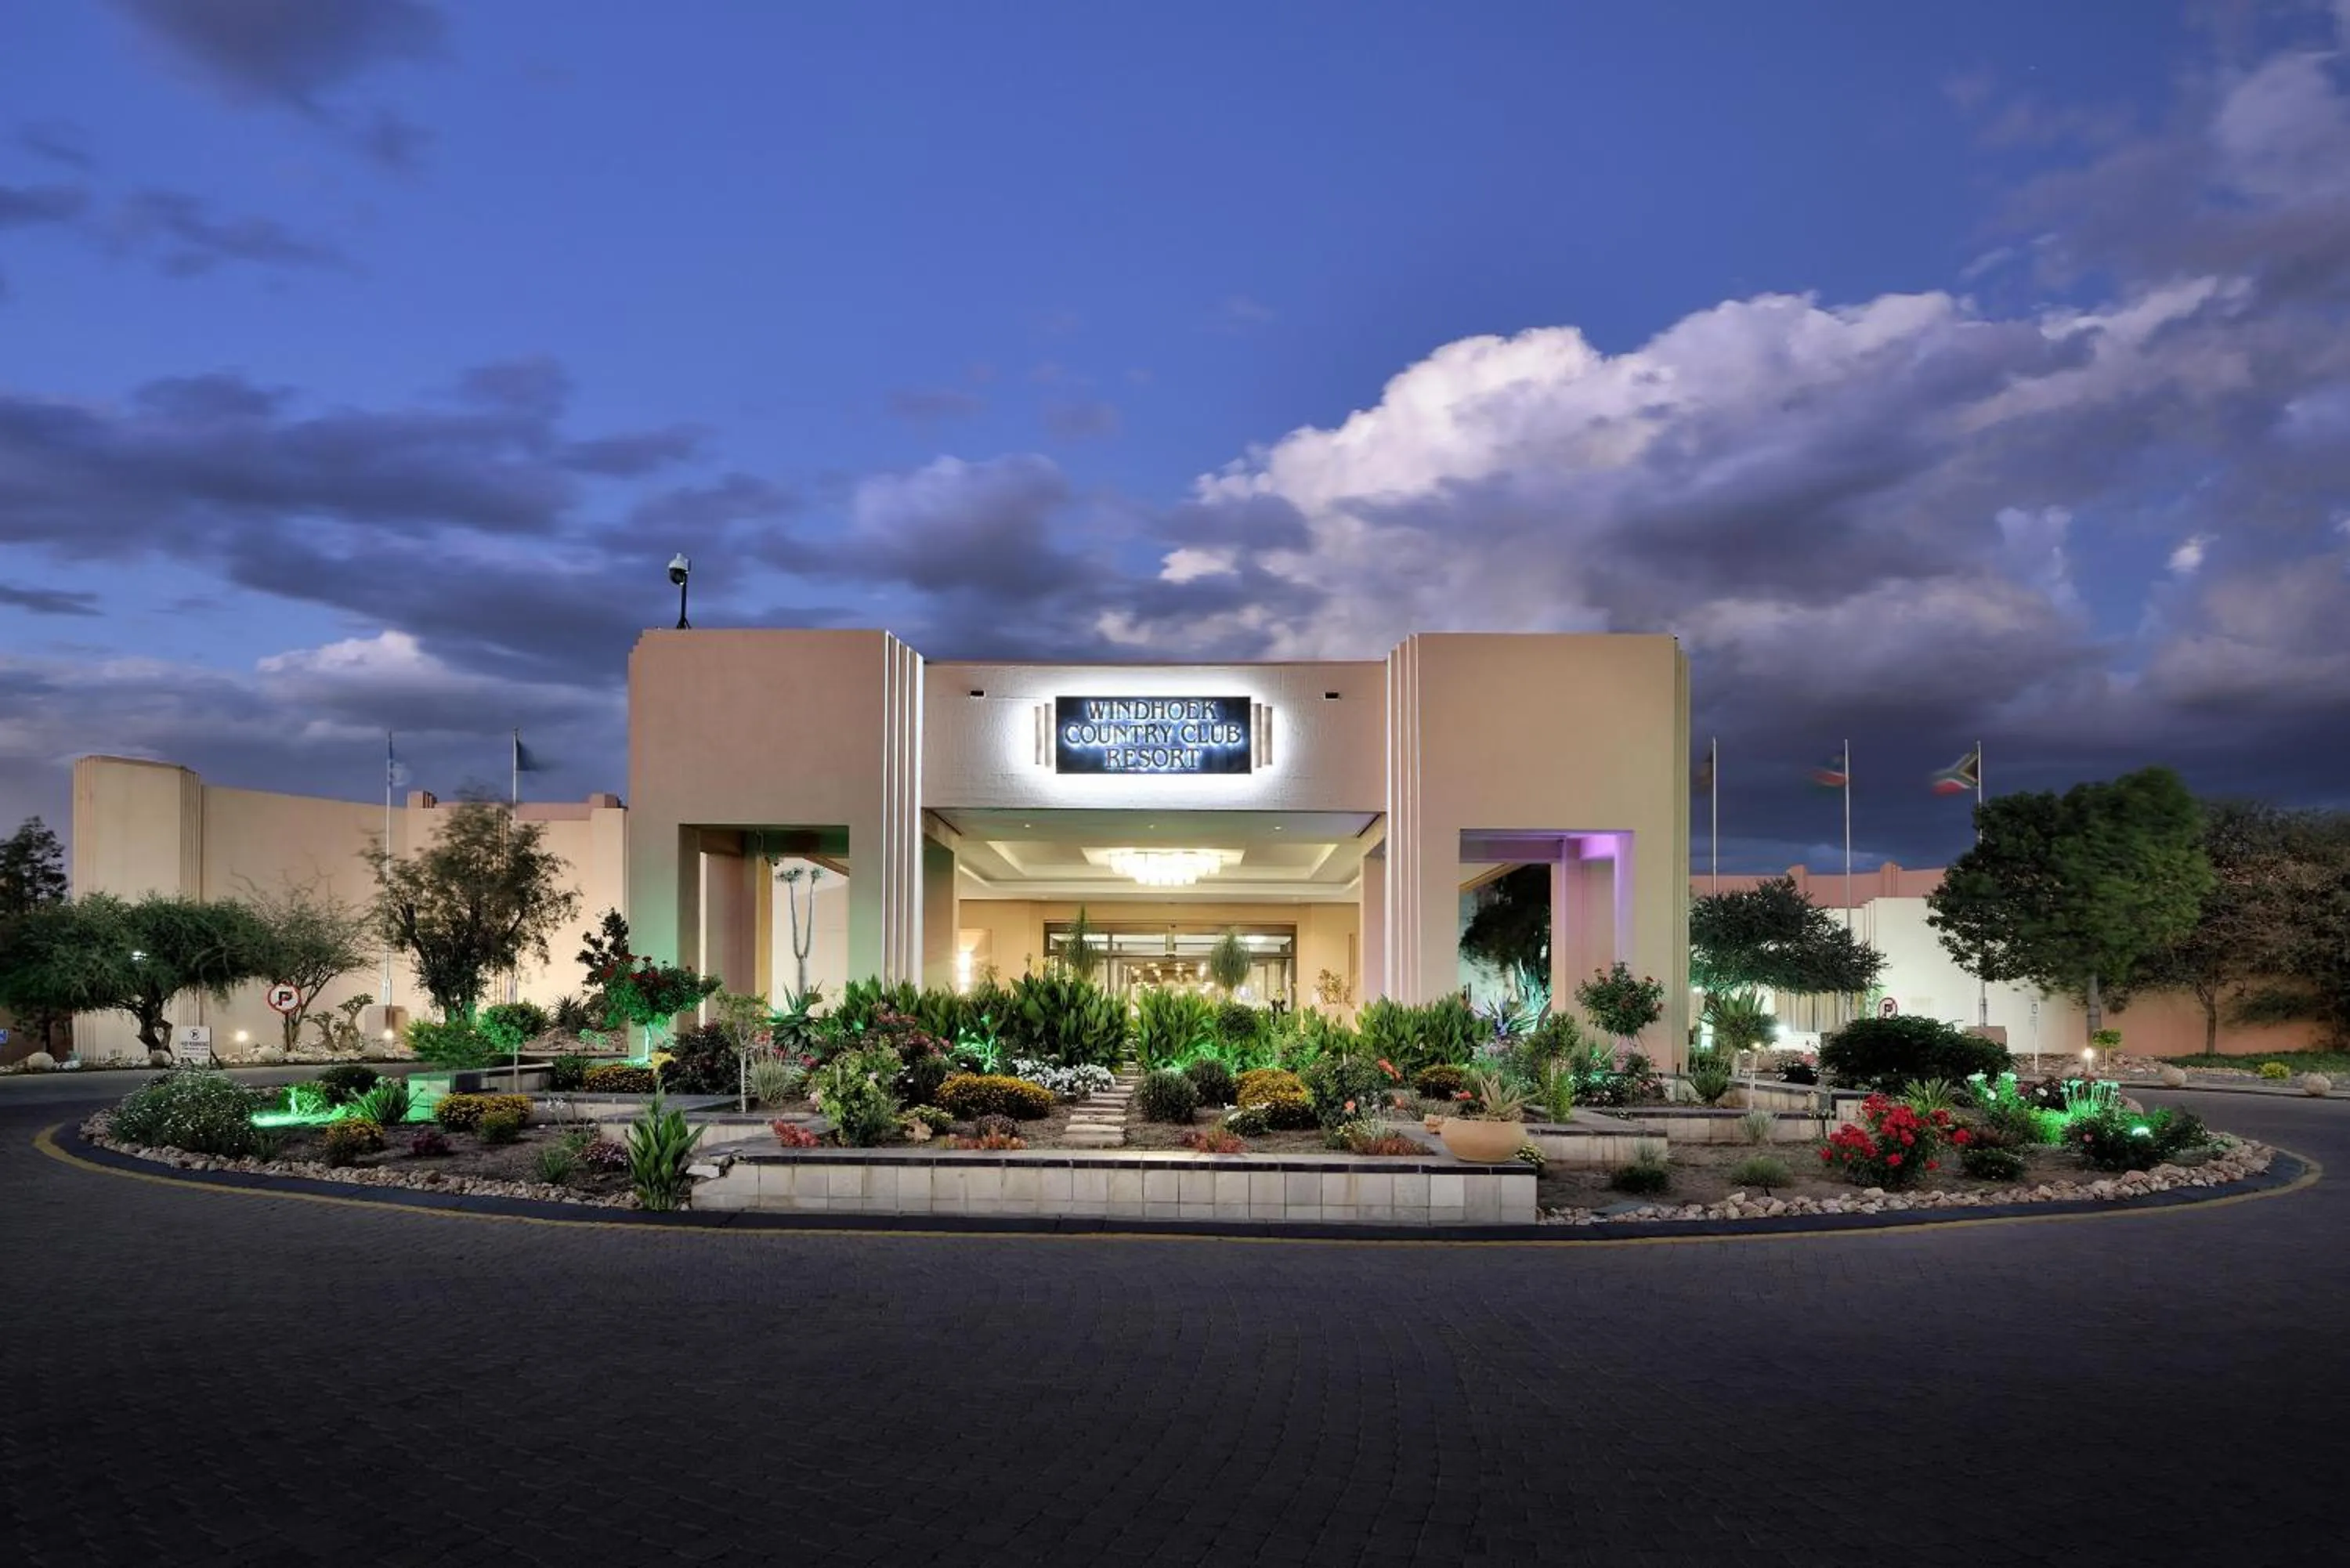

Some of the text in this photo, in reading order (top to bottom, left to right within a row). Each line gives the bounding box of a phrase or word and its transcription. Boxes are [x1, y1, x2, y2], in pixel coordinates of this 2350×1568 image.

[1088, 700, 1217, 720] WINDHOEK
[1064, 724, 1242, 744] COUNTRY CLUB
[1105, 748, 1200, 768] RESORT
[278, 991, 292, 1006] P
